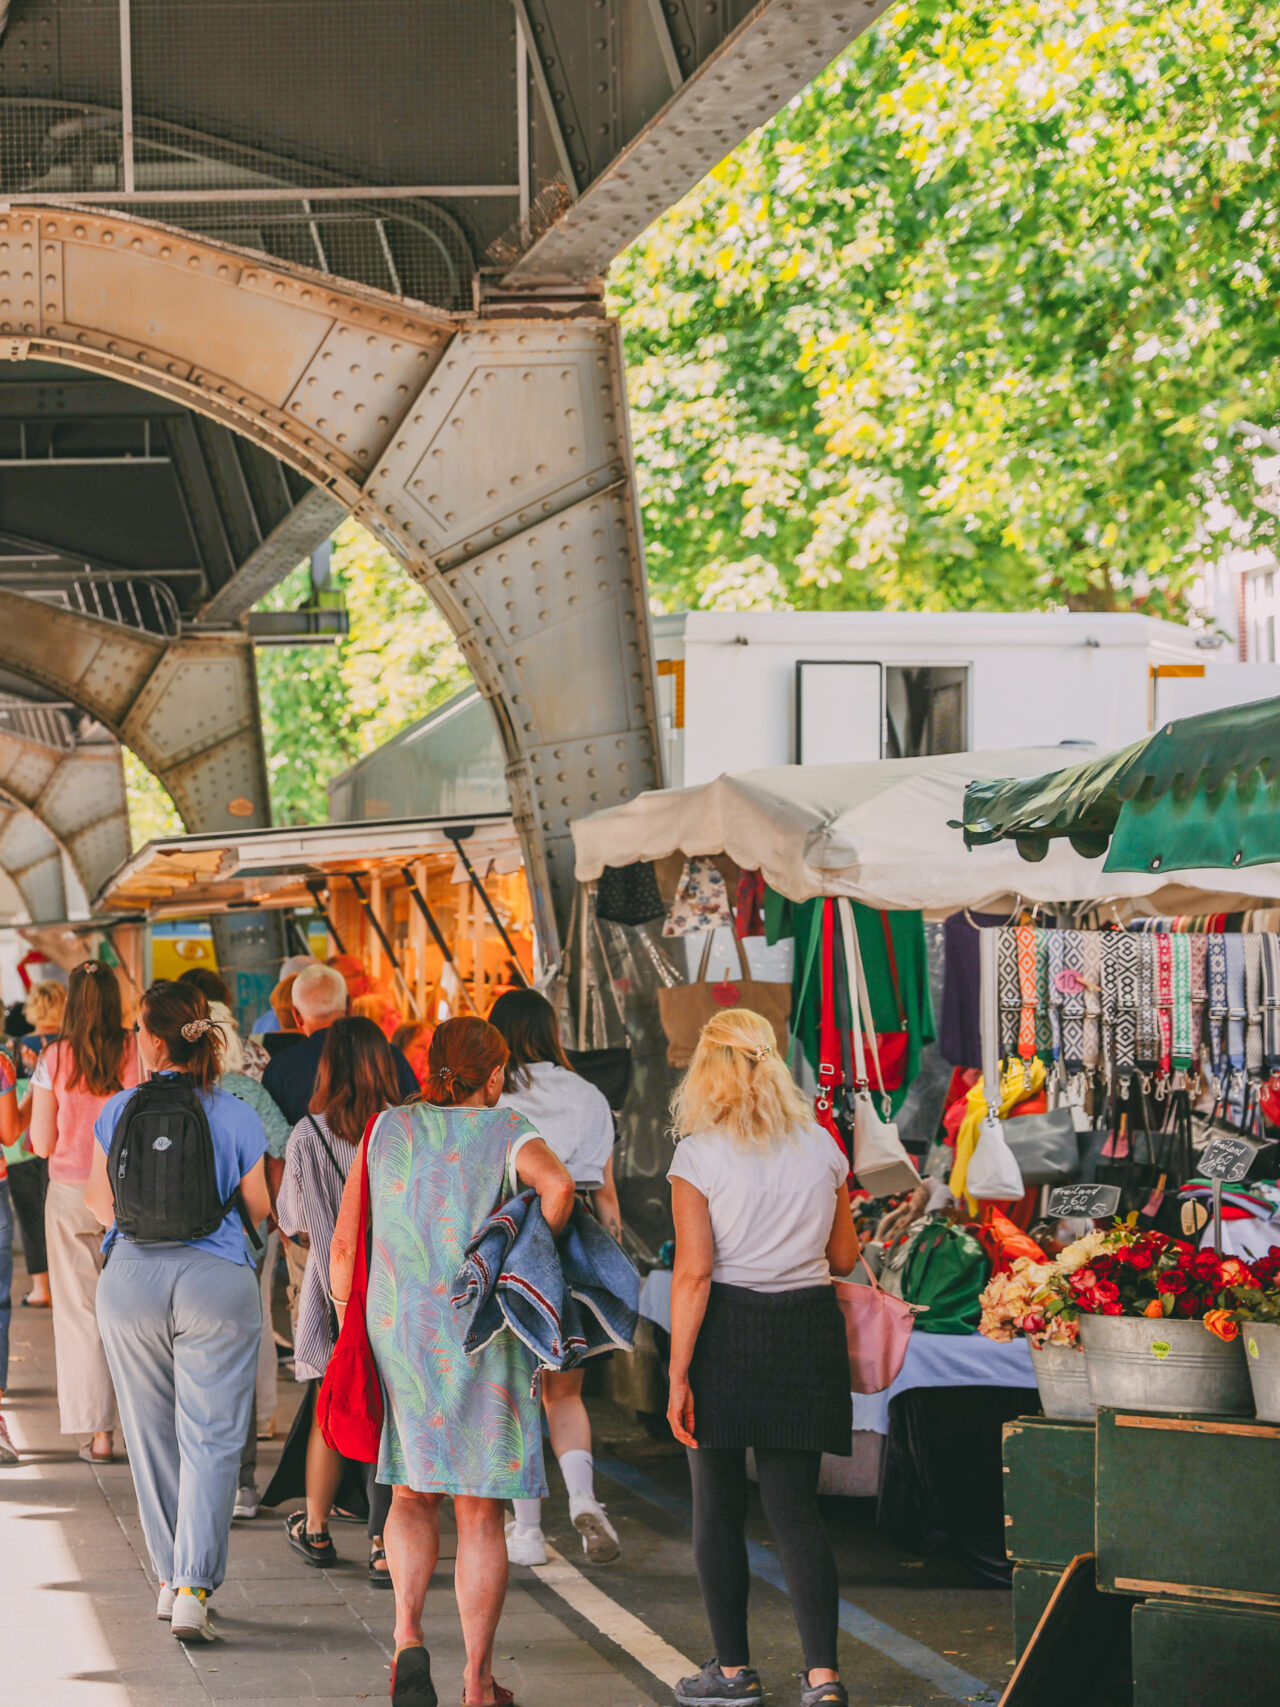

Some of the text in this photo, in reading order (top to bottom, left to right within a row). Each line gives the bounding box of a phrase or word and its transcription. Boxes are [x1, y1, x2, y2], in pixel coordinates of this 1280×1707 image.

[1058, 974, 1076, 990] 10
[1212, 1141, 1247, 1157] Freiland
[1052, 1185, 1102, 1196] Freiland
